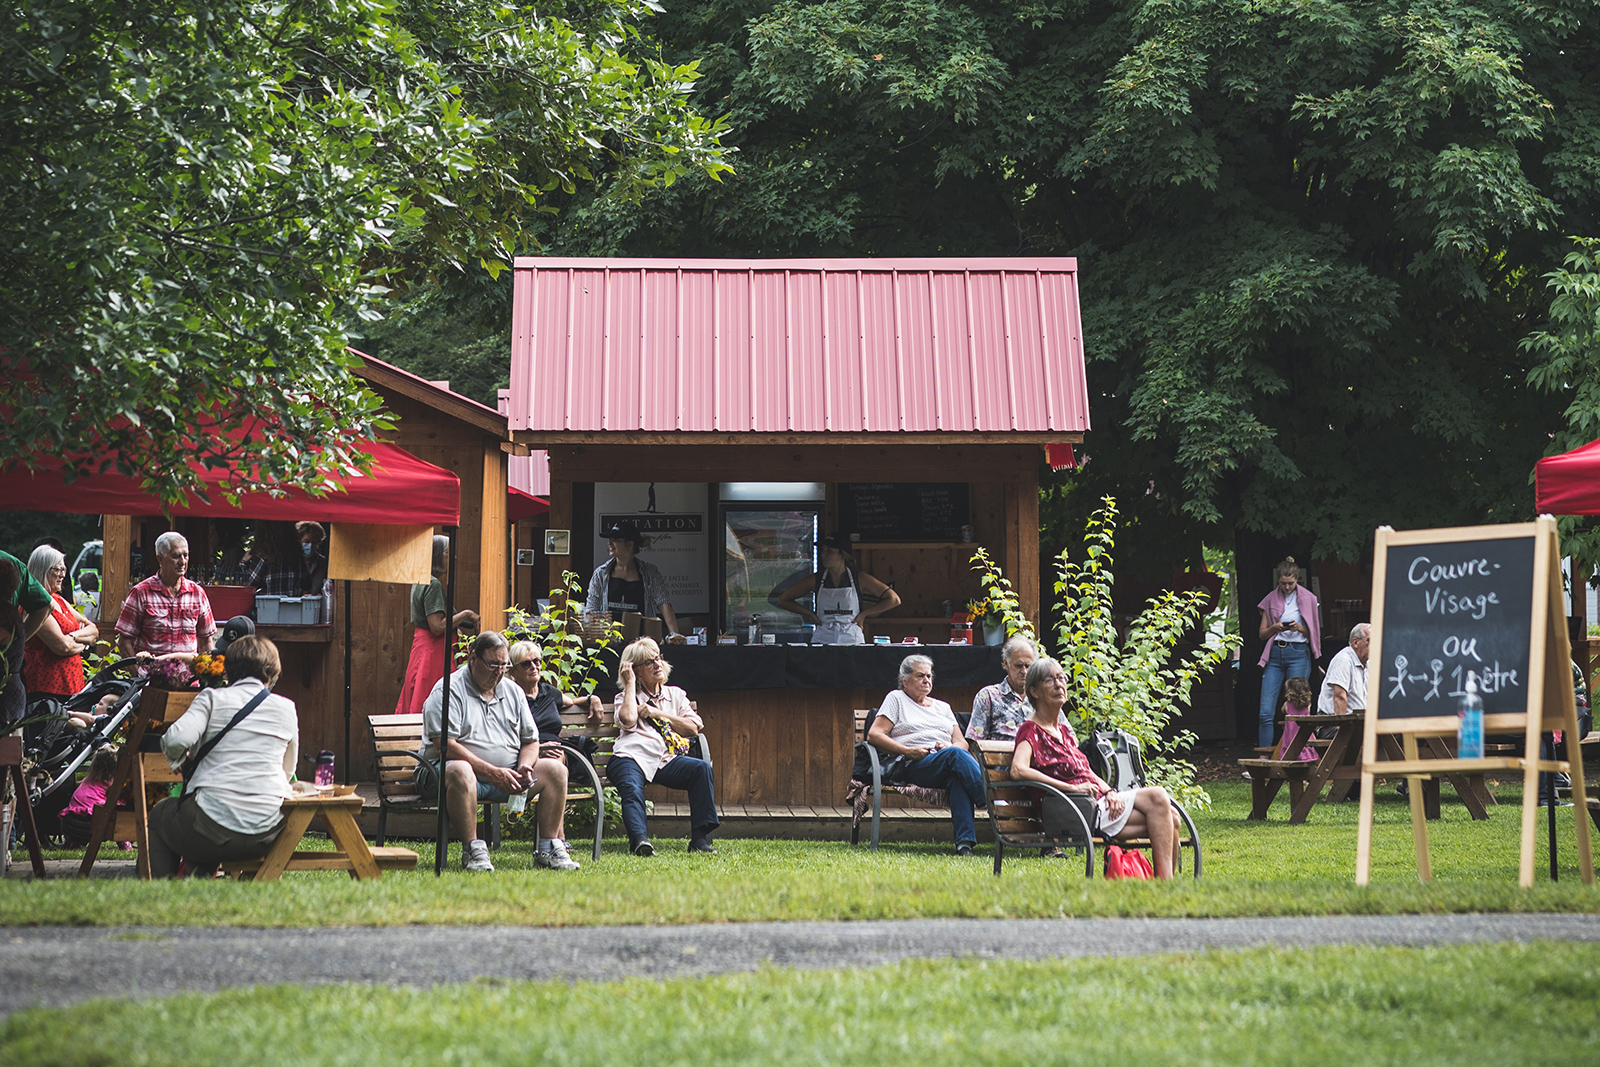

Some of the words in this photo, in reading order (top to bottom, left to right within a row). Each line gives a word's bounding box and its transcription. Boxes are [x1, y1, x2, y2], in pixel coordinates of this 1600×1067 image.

[621, 518, 697, 529] TATION
[1424, 586, 1500, 620] Visage
[1447, 664, 1467, 697] 1
